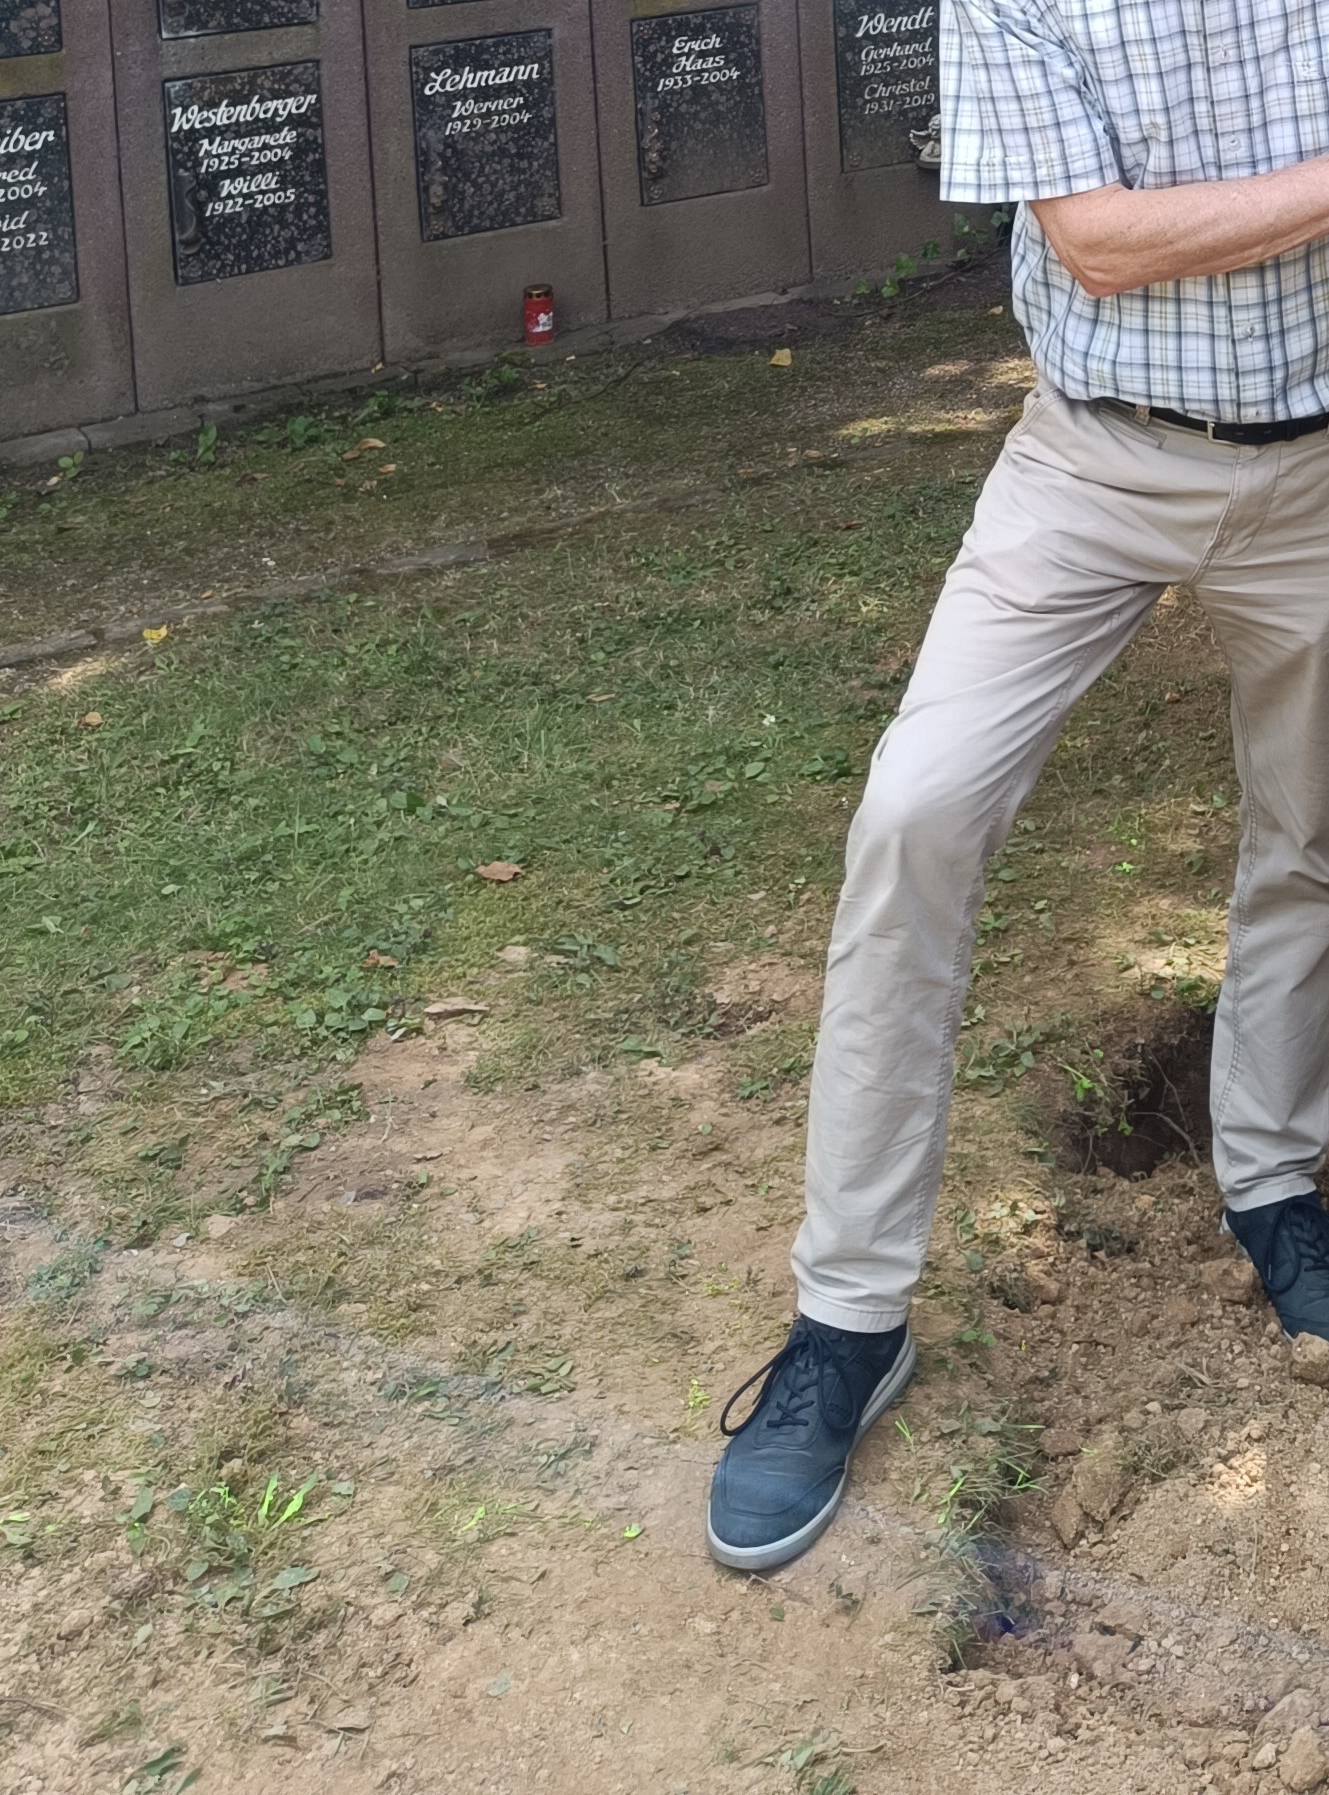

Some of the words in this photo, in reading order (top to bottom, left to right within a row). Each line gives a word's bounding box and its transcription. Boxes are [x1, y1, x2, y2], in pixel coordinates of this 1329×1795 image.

[855, 6, 934, 38] Wendt
[672, 34, 723, 54] Erich
[861, 37, 933, 63] Gerhard
[672, 55, 725, 73] Haas
[424, 63, 540, 95] Lehmann
[657, 67, 740, 91] 1933-2004
[864, 76, 931, 99] Christel
[170, 94, 317, 133] Westenberger
[452, 97, 524, 118] Werner
[445, 110, 532, 135] 1929-2004
[199, 126, 297, 157] Margarete
[201, 147, 293, 173] 1925-2004
[219, 171, 281, 198] Willi
[205, 189, 295, 217] 1922-2005
